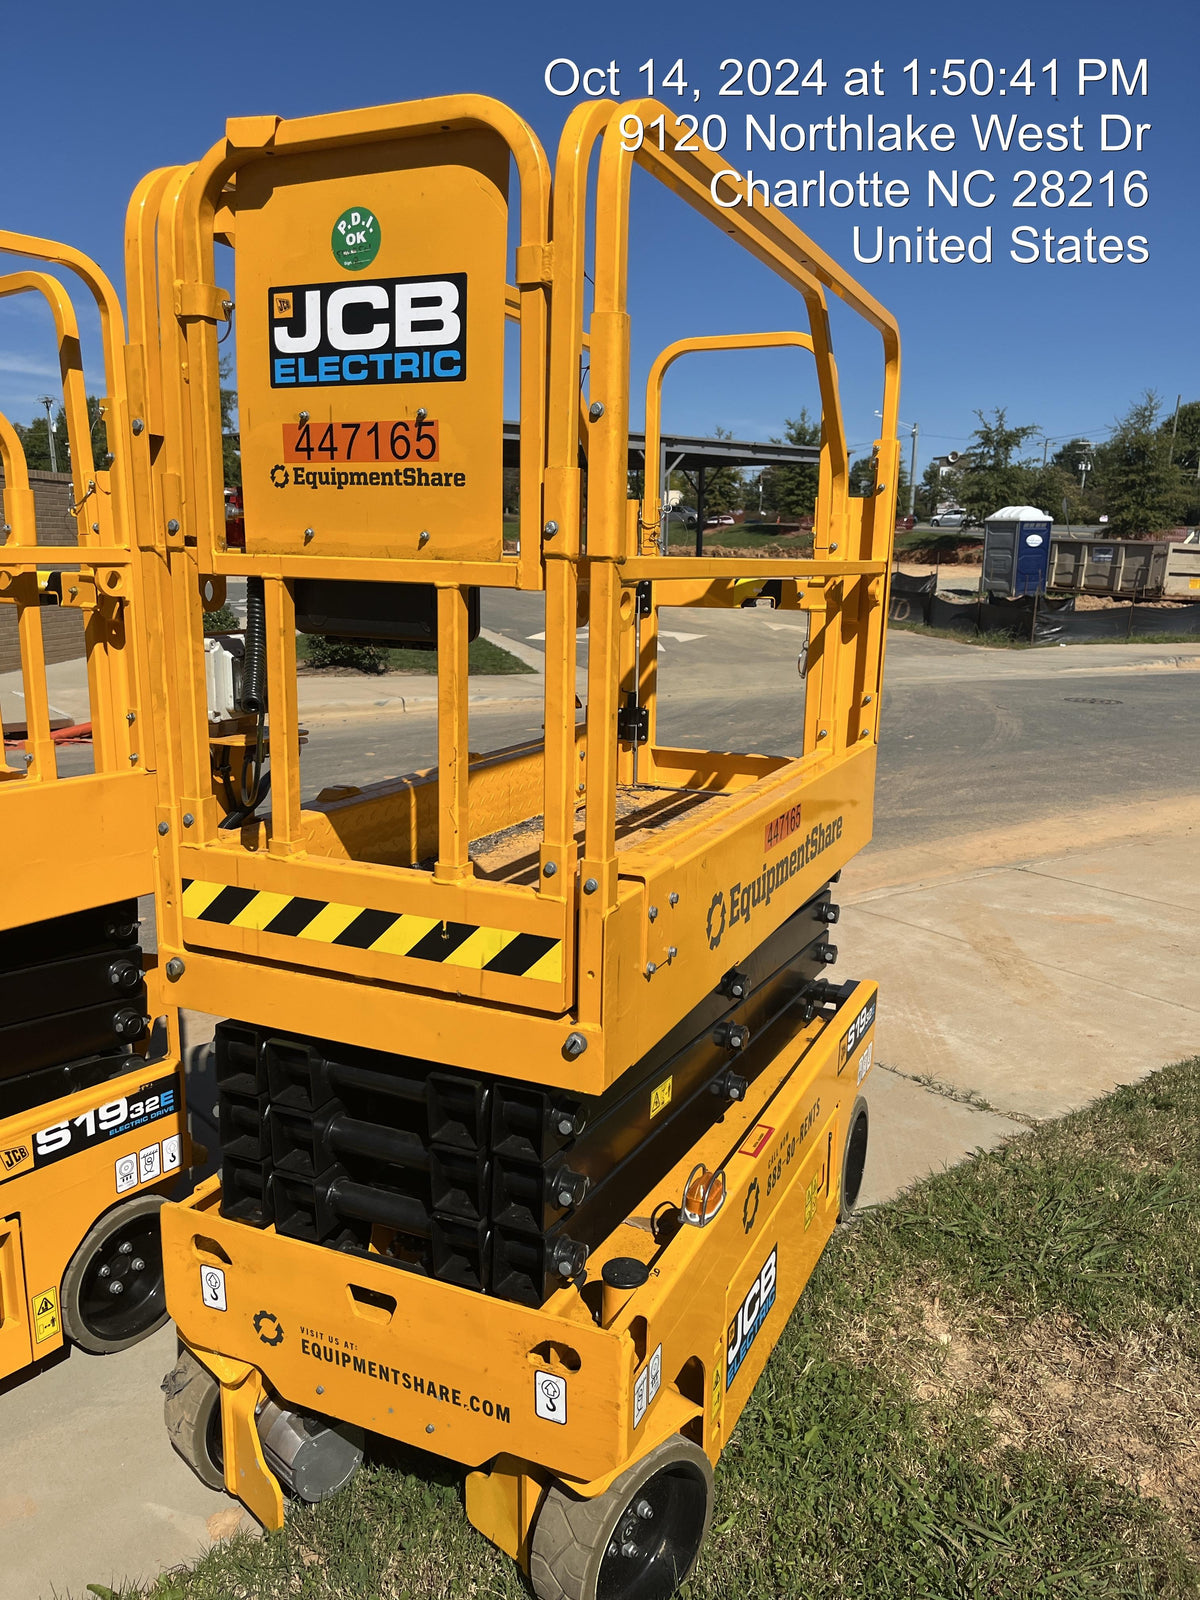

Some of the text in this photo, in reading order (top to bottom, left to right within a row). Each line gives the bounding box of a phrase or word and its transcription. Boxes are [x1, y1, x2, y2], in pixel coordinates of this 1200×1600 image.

[337, 211, 374, 235] P.D.I.
[345, 230, 367, 246] OK
[273, 281, 461, 354] JCB
[274, 350, 461, 384] ELECTRIC
[294, 421, 437, 461] 447165
[293, 467, 466, 490] EquipmentShare
[767, 803, 801, 846] 447165
[728, 815, 843, 928] EquipmentShare
[109, 1105, 175, 1136] ELECTRIC DRIVE
[4, 1147, 27, 1168] JCB
[766, 1097, 820, 1196] 888-80-RENTS
[728, 1250, 776, 1365] JCB
[300, 1326, 358, 1350] VISIT US AT:
[727, 1285, 775, 1388] ELECTRIC
[301, 1338, 511, 1424] EQUIPMENTSHARE.COM
